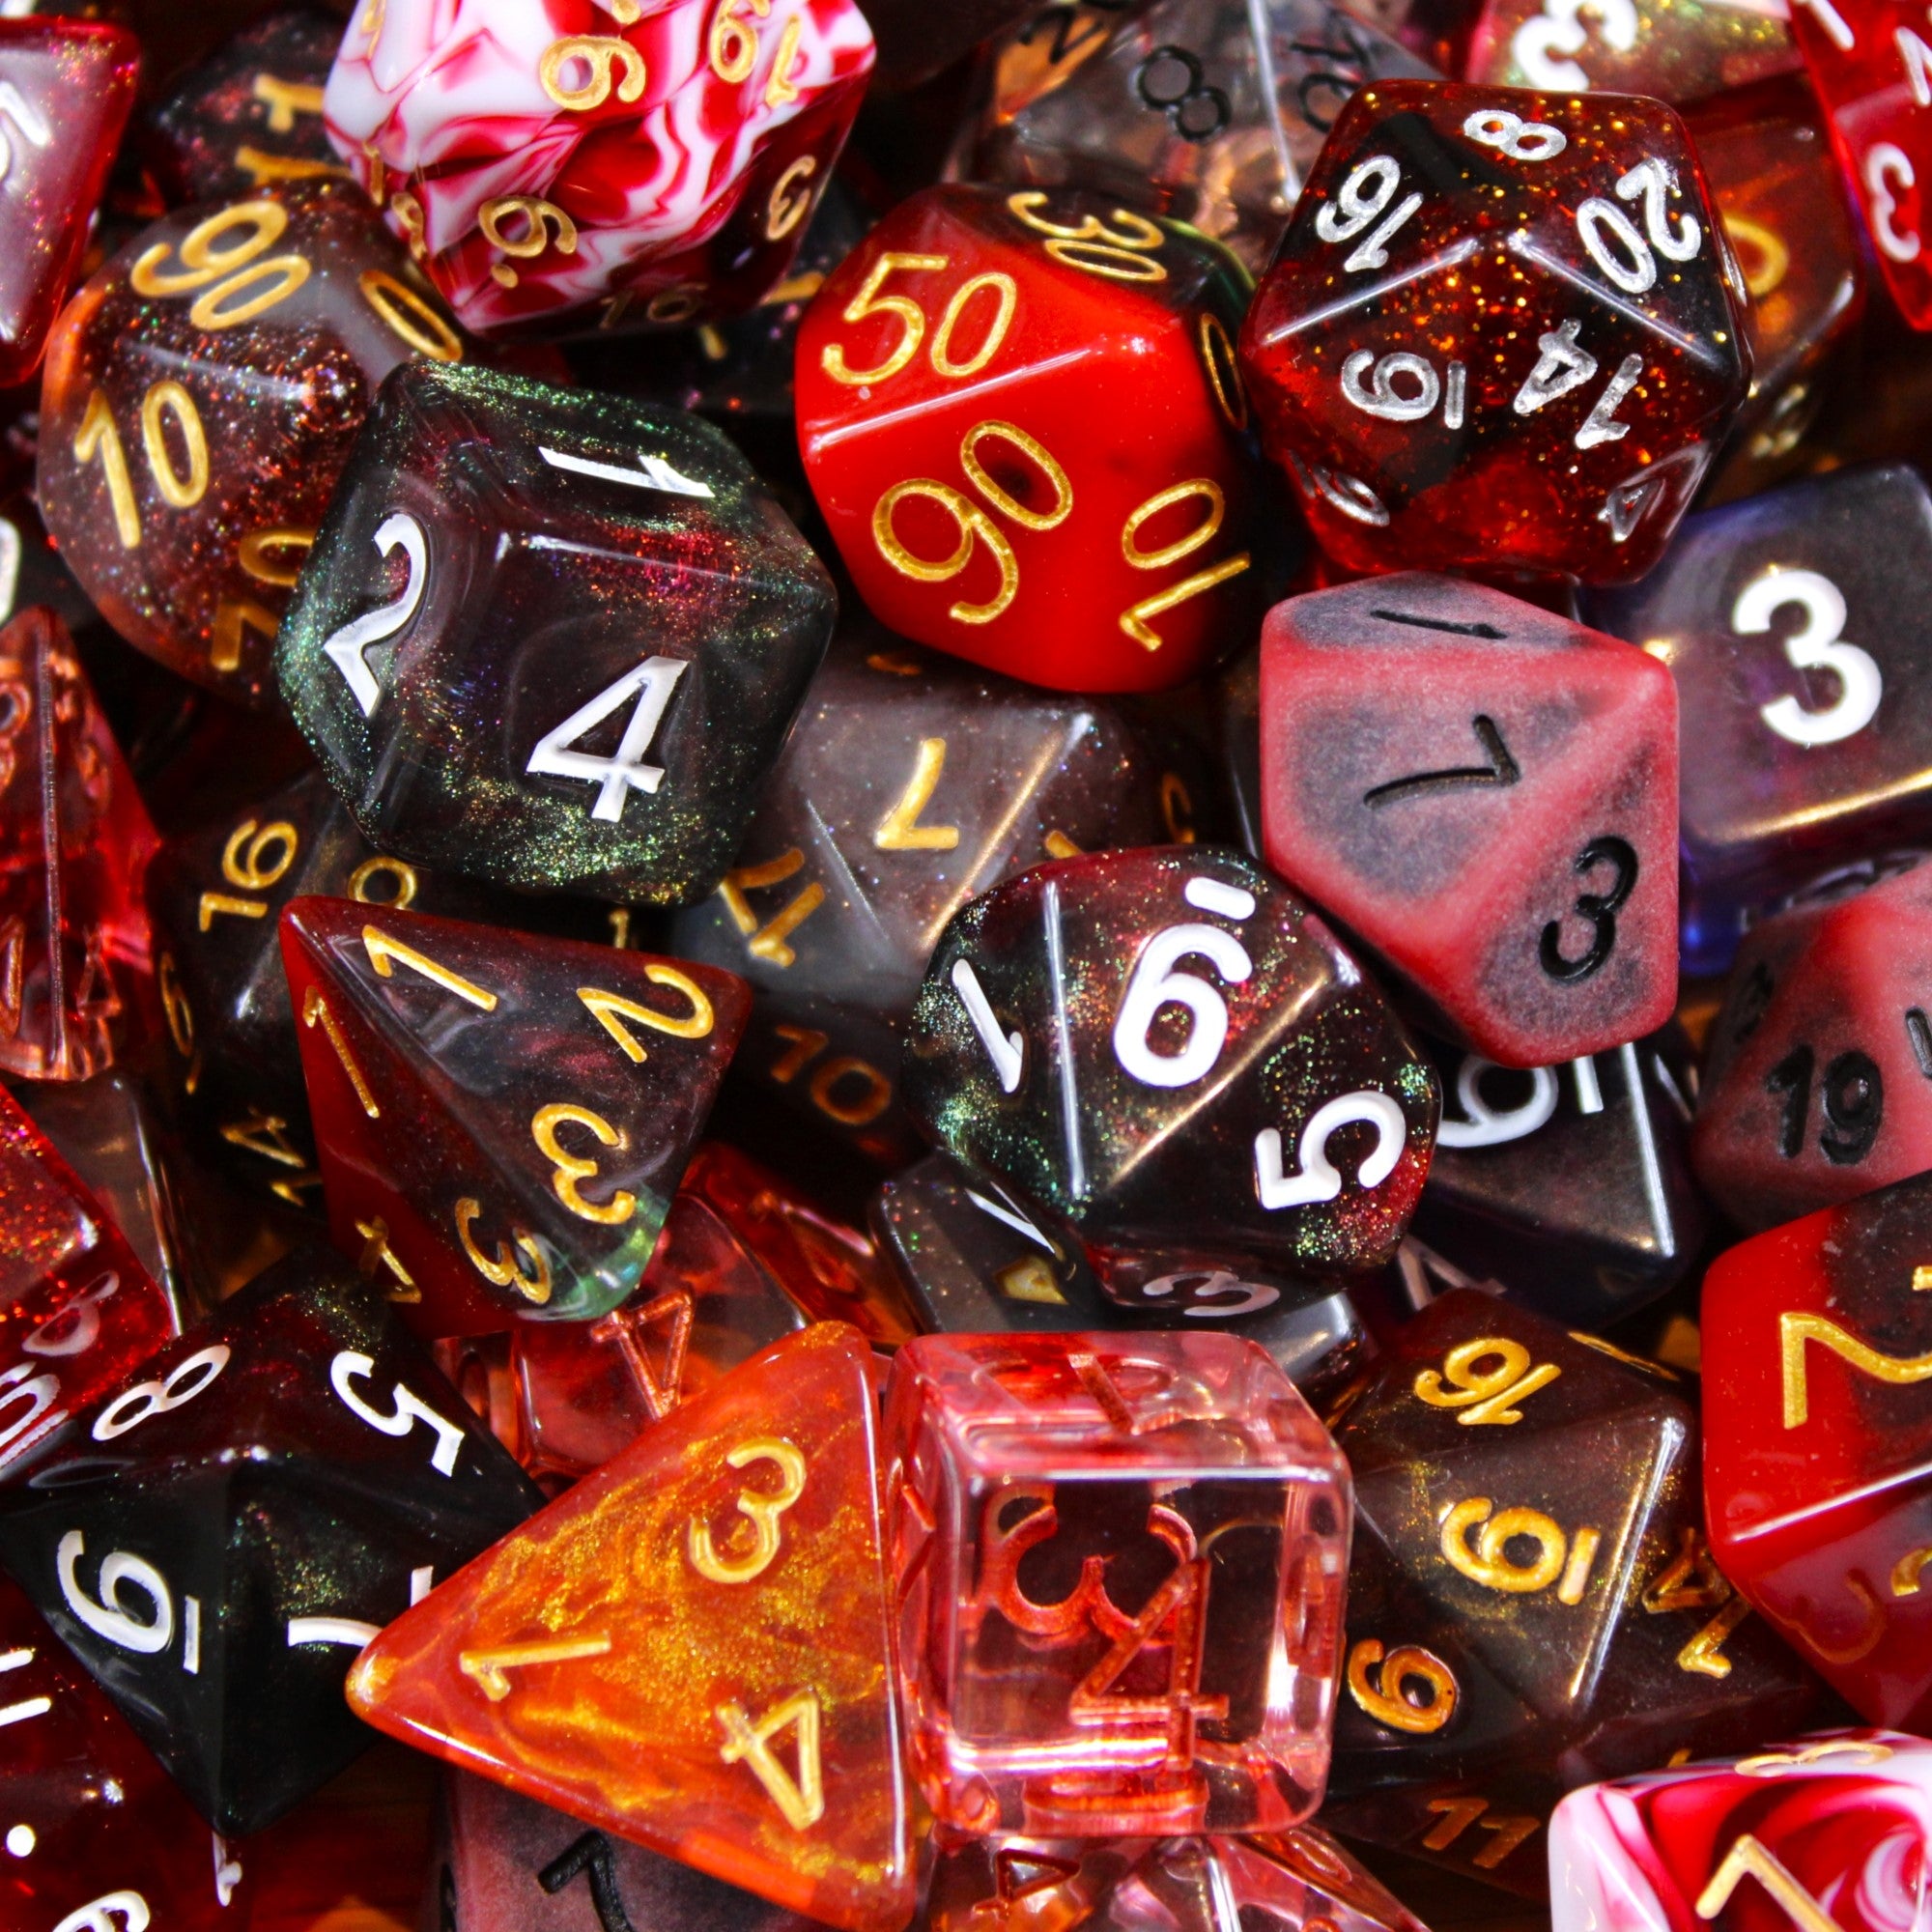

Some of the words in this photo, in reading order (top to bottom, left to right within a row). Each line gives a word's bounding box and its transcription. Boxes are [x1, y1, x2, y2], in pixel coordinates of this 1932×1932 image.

[1131, 43, 1234, 143] 8
[1463, 109, 1568, 161] 8
[130, 200, 312, 331] 90
[1008, 192, 1168, 282] 30
[1577, 156, 1702, 294] 20
[1865, 141, 1921, 263] 3
[822, 251, 1017, 385] 50
[1513, 318, 1643, 450] 14
[73, 381, 209, 550] 10
[537, 446, 716, 499] 1
[871, 419, 1075, 624] 90
[323, 512, 427, 719] 2
[1120, 477, 1251, 653] 10
[1733, 563, 1884, 747] 3
[526, 655, 690, 823] 4
[874, 737, 960, 850] 7
[362, 923, 498, 1012] 1
[1538, 834, 1639, 984] 3
[302, 984, 381, 1119] 1
[576, 964, 715, 1064] 2
[950, 958, 1025, 1094] 1
[531, 1102, 636, 1225] 3
[1255, 1090, 1407, 1210] 5
[1764, 1042, 1885, 1166] 19
[21, 1269, 121, 1357] 8
[454, 1196, 553, 1305] 3
[1143, 1269, 1281, 1318] 3
[92, 1344, 231, 1441] 8
[329, 1350, 465, 1477] 5
[689, 1435, 807, 1584] 3
[458, 1629, 612, 1703] 1
[1068, 1557, 1230, 1771] 4
[715, 1686, 825, 1833] 4
